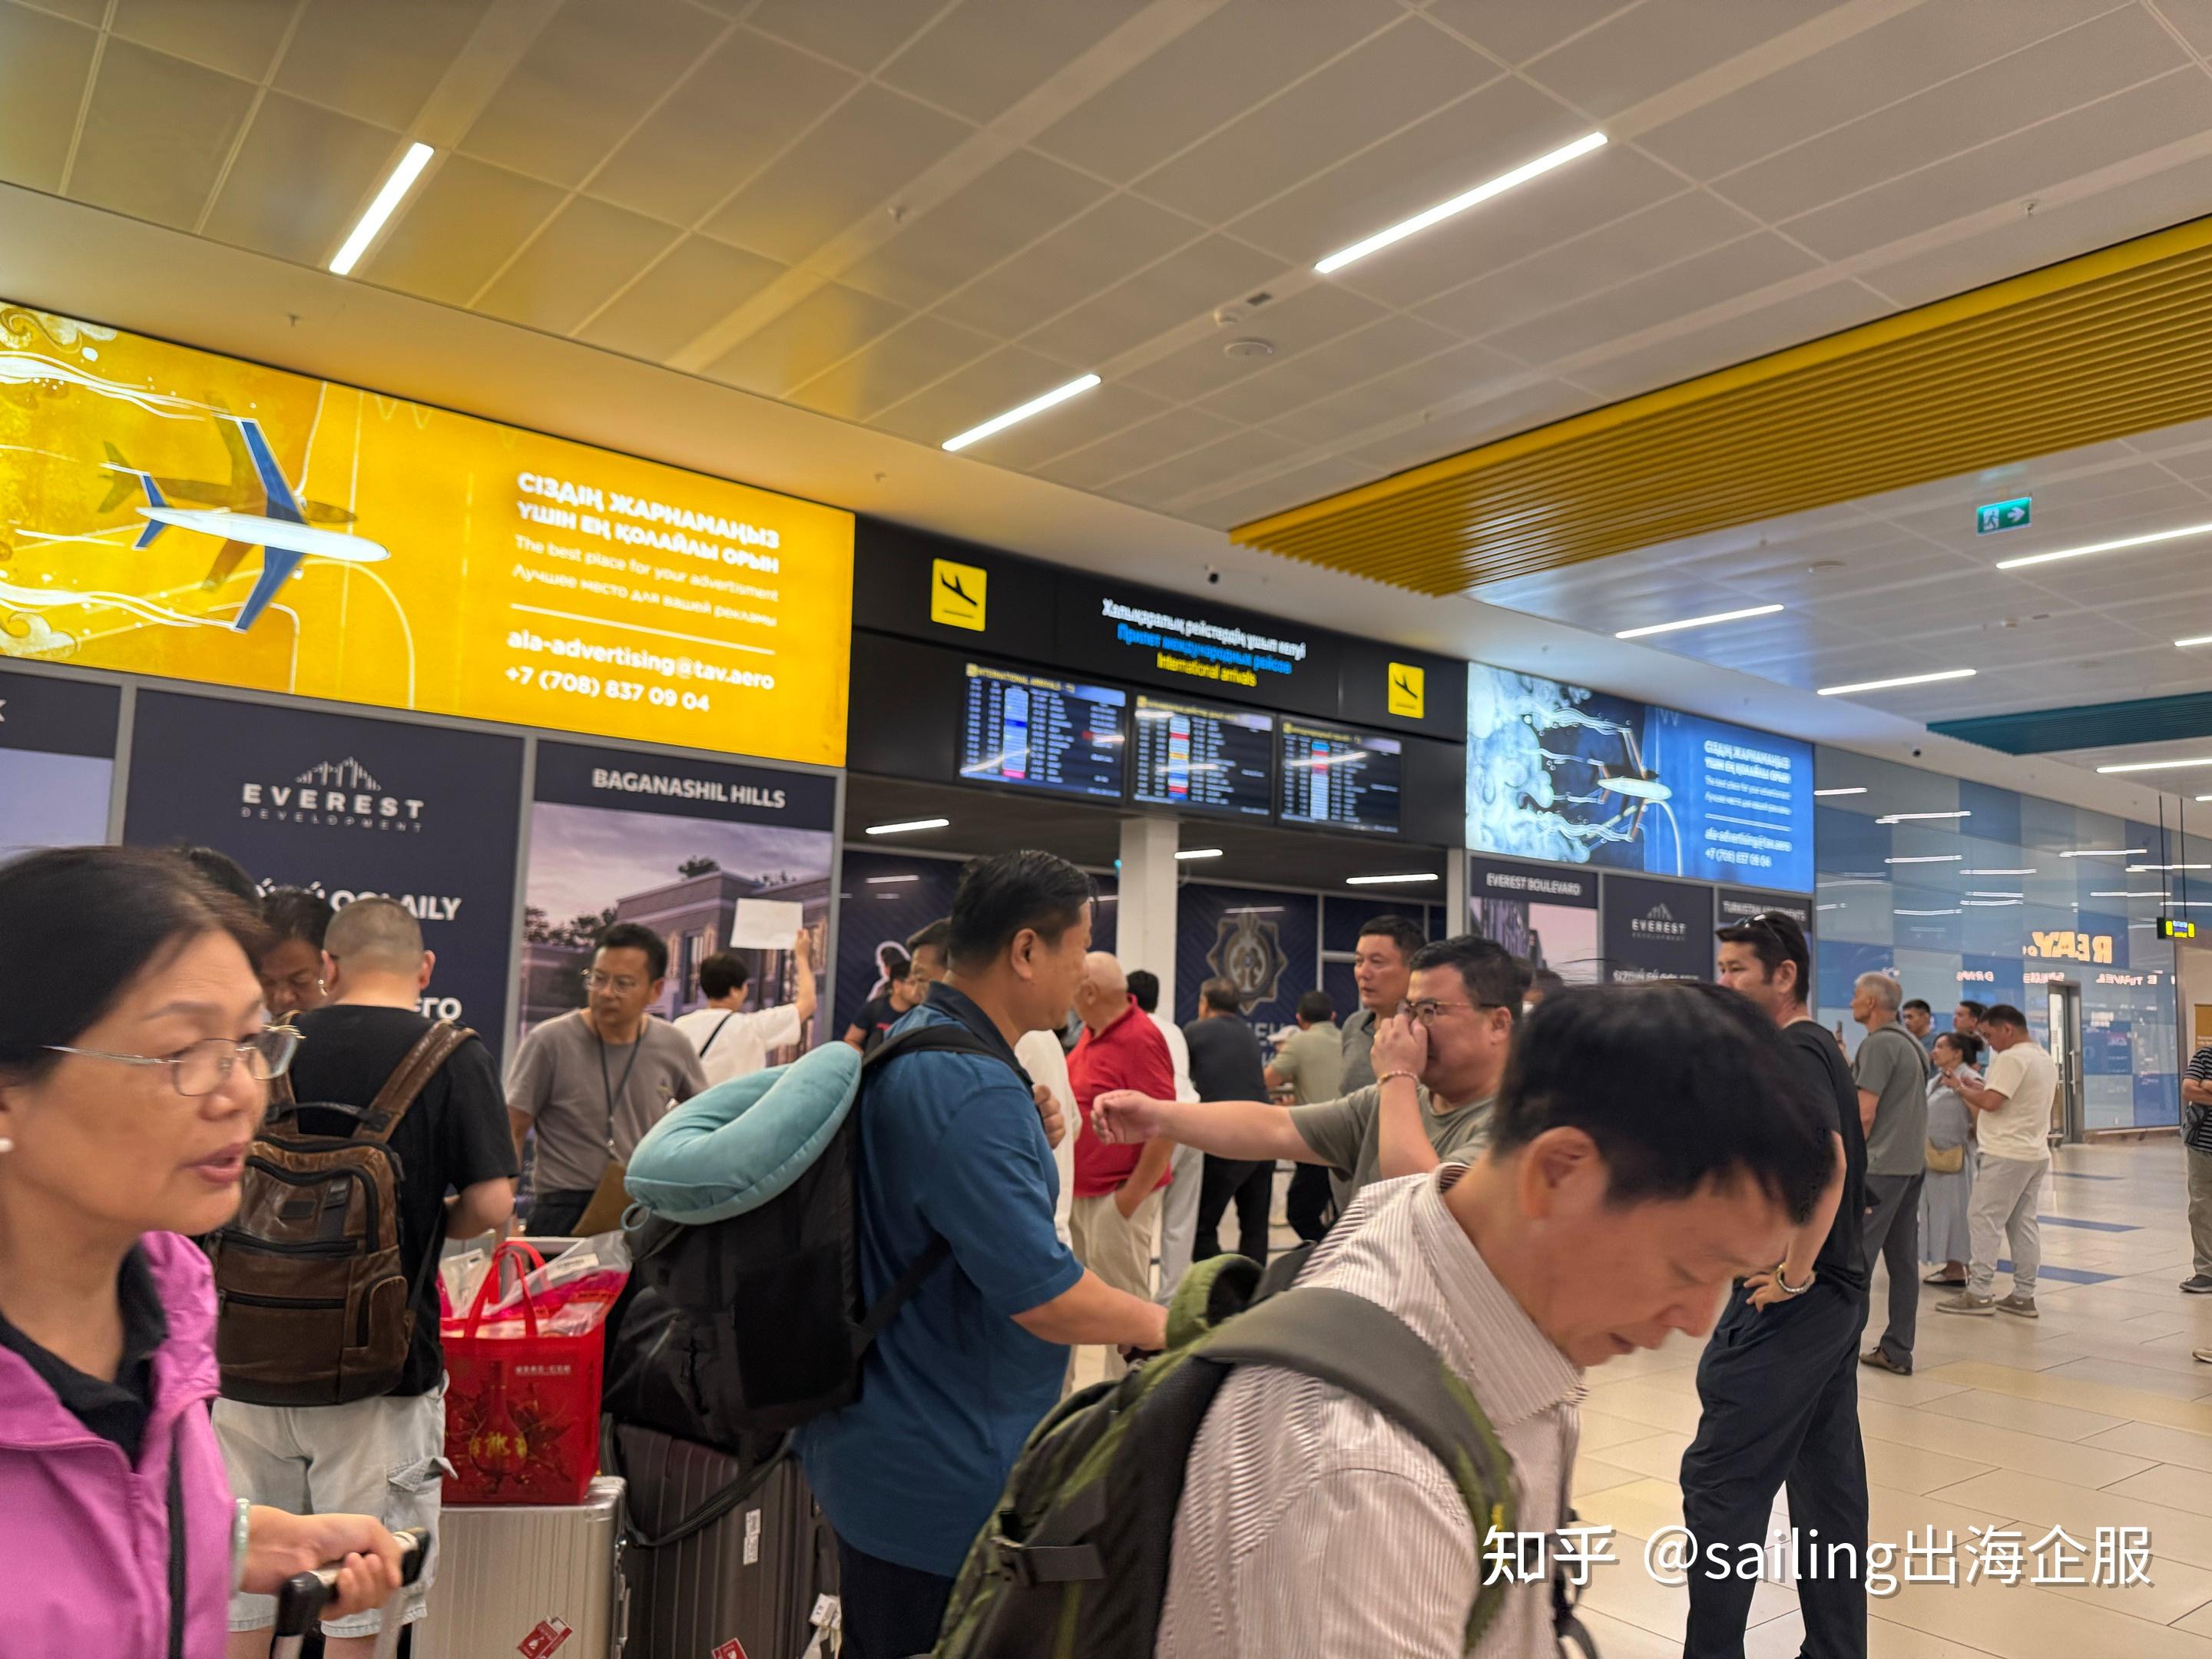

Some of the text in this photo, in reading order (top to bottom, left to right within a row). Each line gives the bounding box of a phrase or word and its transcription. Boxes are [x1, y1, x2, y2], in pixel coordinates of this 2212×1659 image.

[515, 534, 545, 555] The
[547, 541, 581, 562] best
[584, 549, 627, 571] place
[629, 558, 651, 575] for
[653, 566, 687, 583] your
[512, 563, 578, 588] Лучшее
[579, 578, 628, 599] место
[629, 588, 661, 605] для
[662, 594, 712, 614] вашей
[506, 629, 775, 690] ala-advertising@tav.aero
[504, 665, 710, 713] +7 (708) 837 09 04
[242, 783, 424, 820] EVEREST
[592, 767, 786, 809] BAGANASHIL HILLS
[240, 806, 422, 833] DEVELOPMENT
[1632, 919, 1686, 934] EVEREST
